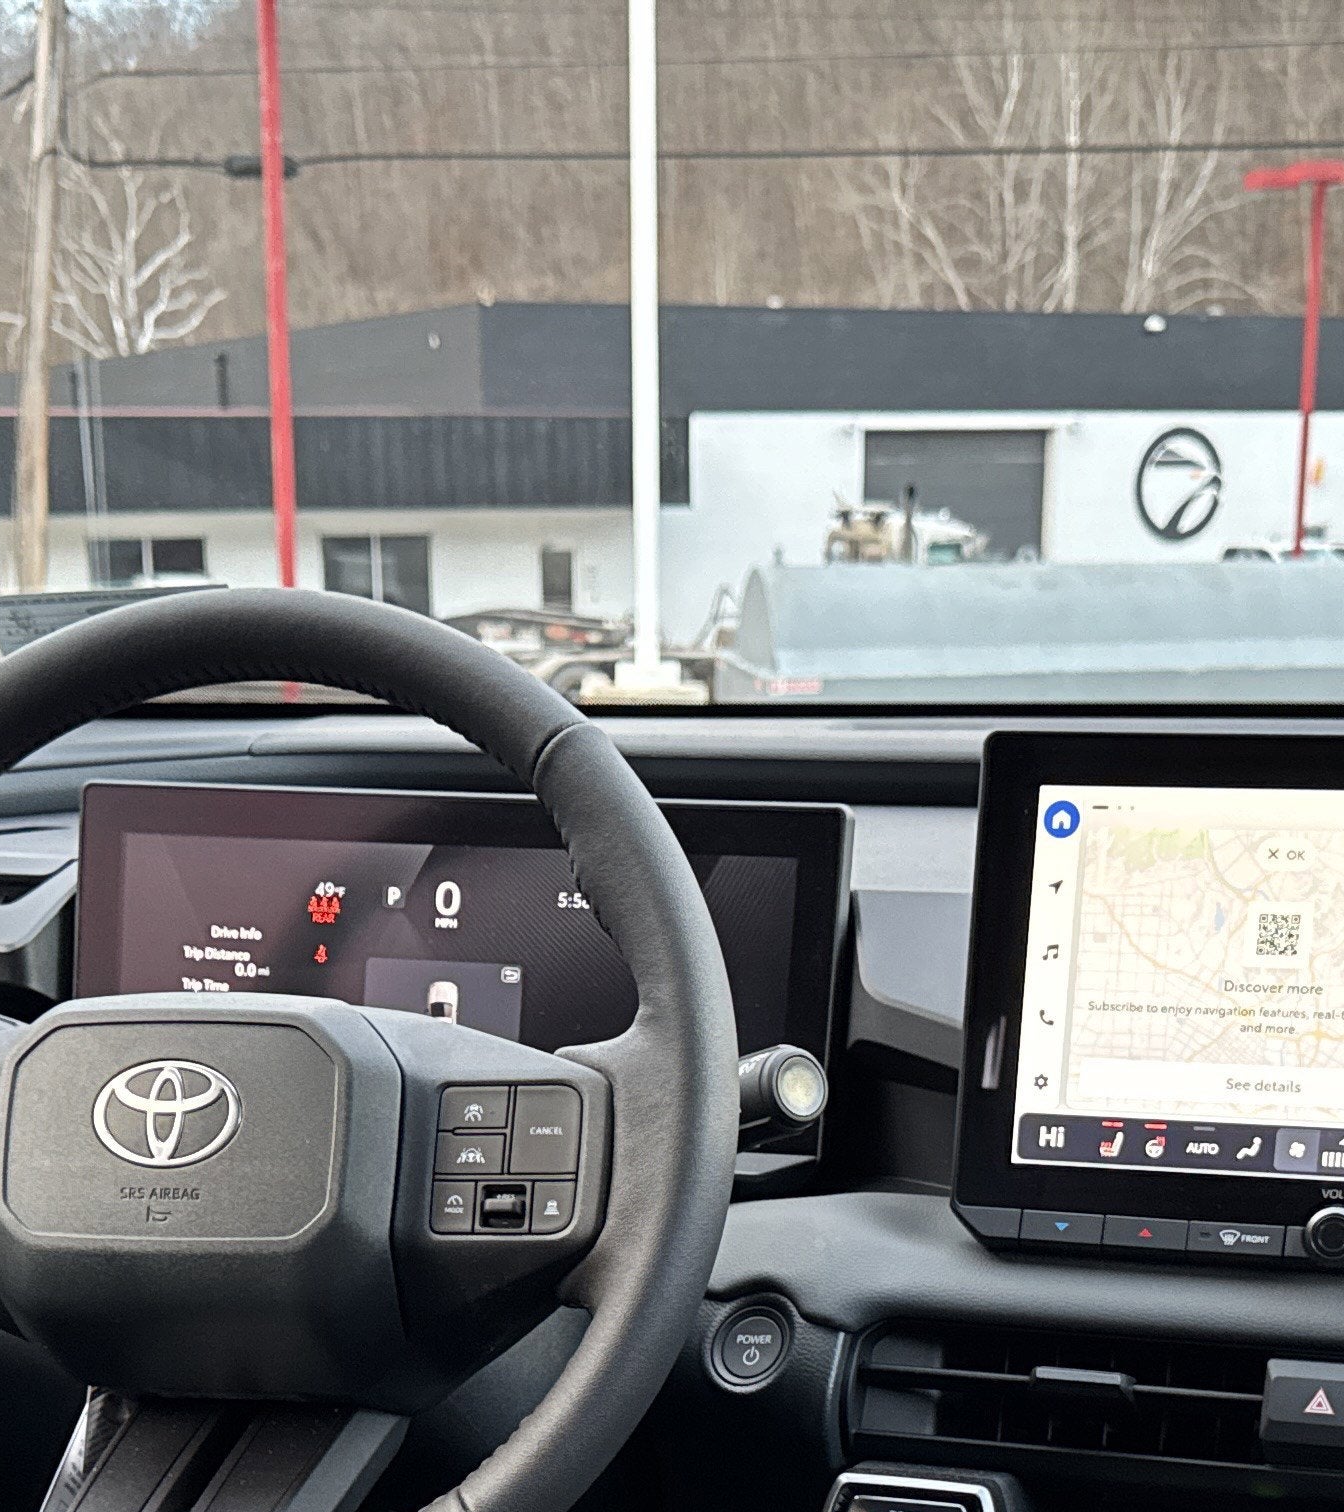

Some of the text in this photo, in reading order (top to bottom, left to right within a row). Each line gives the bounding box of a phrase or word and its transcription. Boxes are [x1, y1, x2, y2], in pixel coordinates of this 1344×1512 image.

[1286, 849, 1306, 861] OK
[387, 886, 402, 906] P
[435, 880, 461, 917] 0
[210, 924, 263, 941] Drive Info
[183, 945, 251, 962] Trip Distance
[234, 962, 257, 978] 0.0
[181, 977, 230, 993] Trip Time
[1223, 979, 1323, 996] Discover more
[1088, 1000, 1143, 1013] Subscribe
[1146, 1004, 1158, 1013] to
[1160, 1006, 1193, 1017] enjoy
[1194, 1006, 1256, 1019] navigation
[1259, 1006, 1310, 1020] features,
[1240, 1022, 1262, 1034] and
[1226, 1078, 1302, 1094] See details
[529, 1126, 563, 1137] CANCEL
[1038, 1125, 1065, 1149] Hi
[1185, 1141, 1219, 1156] AUTO
[119, 1186, 200, 1201] SRS AIRBAG
[1321, 1188, 1344, 1200] VOL
[1240, 1233, 1271, 1245] FRONT
[736, 1333, 772, 1345] POWER
